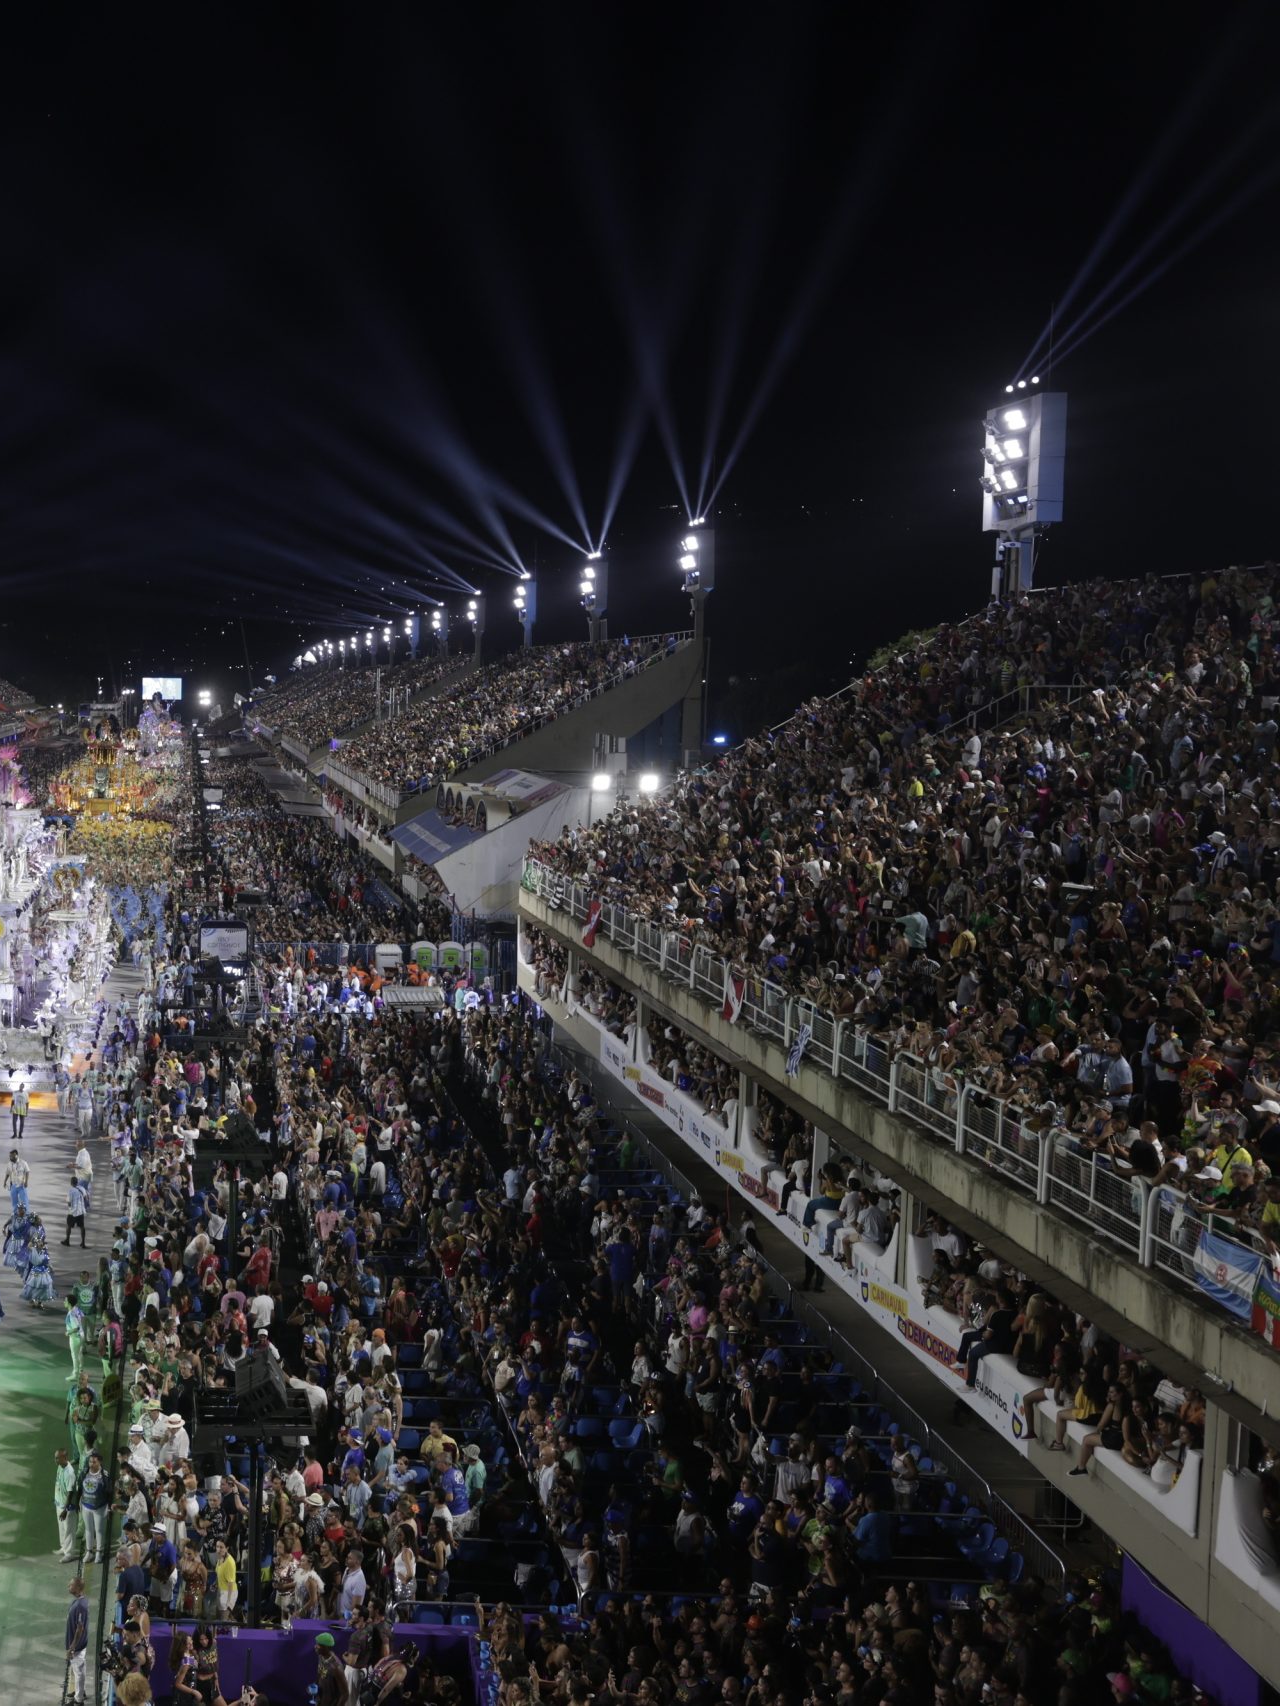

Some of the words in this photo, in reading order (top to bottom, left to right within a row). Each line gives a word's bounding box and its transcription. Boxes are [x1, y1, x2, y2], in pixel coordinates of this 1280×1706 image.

[872, 1285, 907, 1317] CARNAVAL
[908, 1323, 965, 1377] DEMOCRAC
[984, 1386, 1009, 1414] samba.
